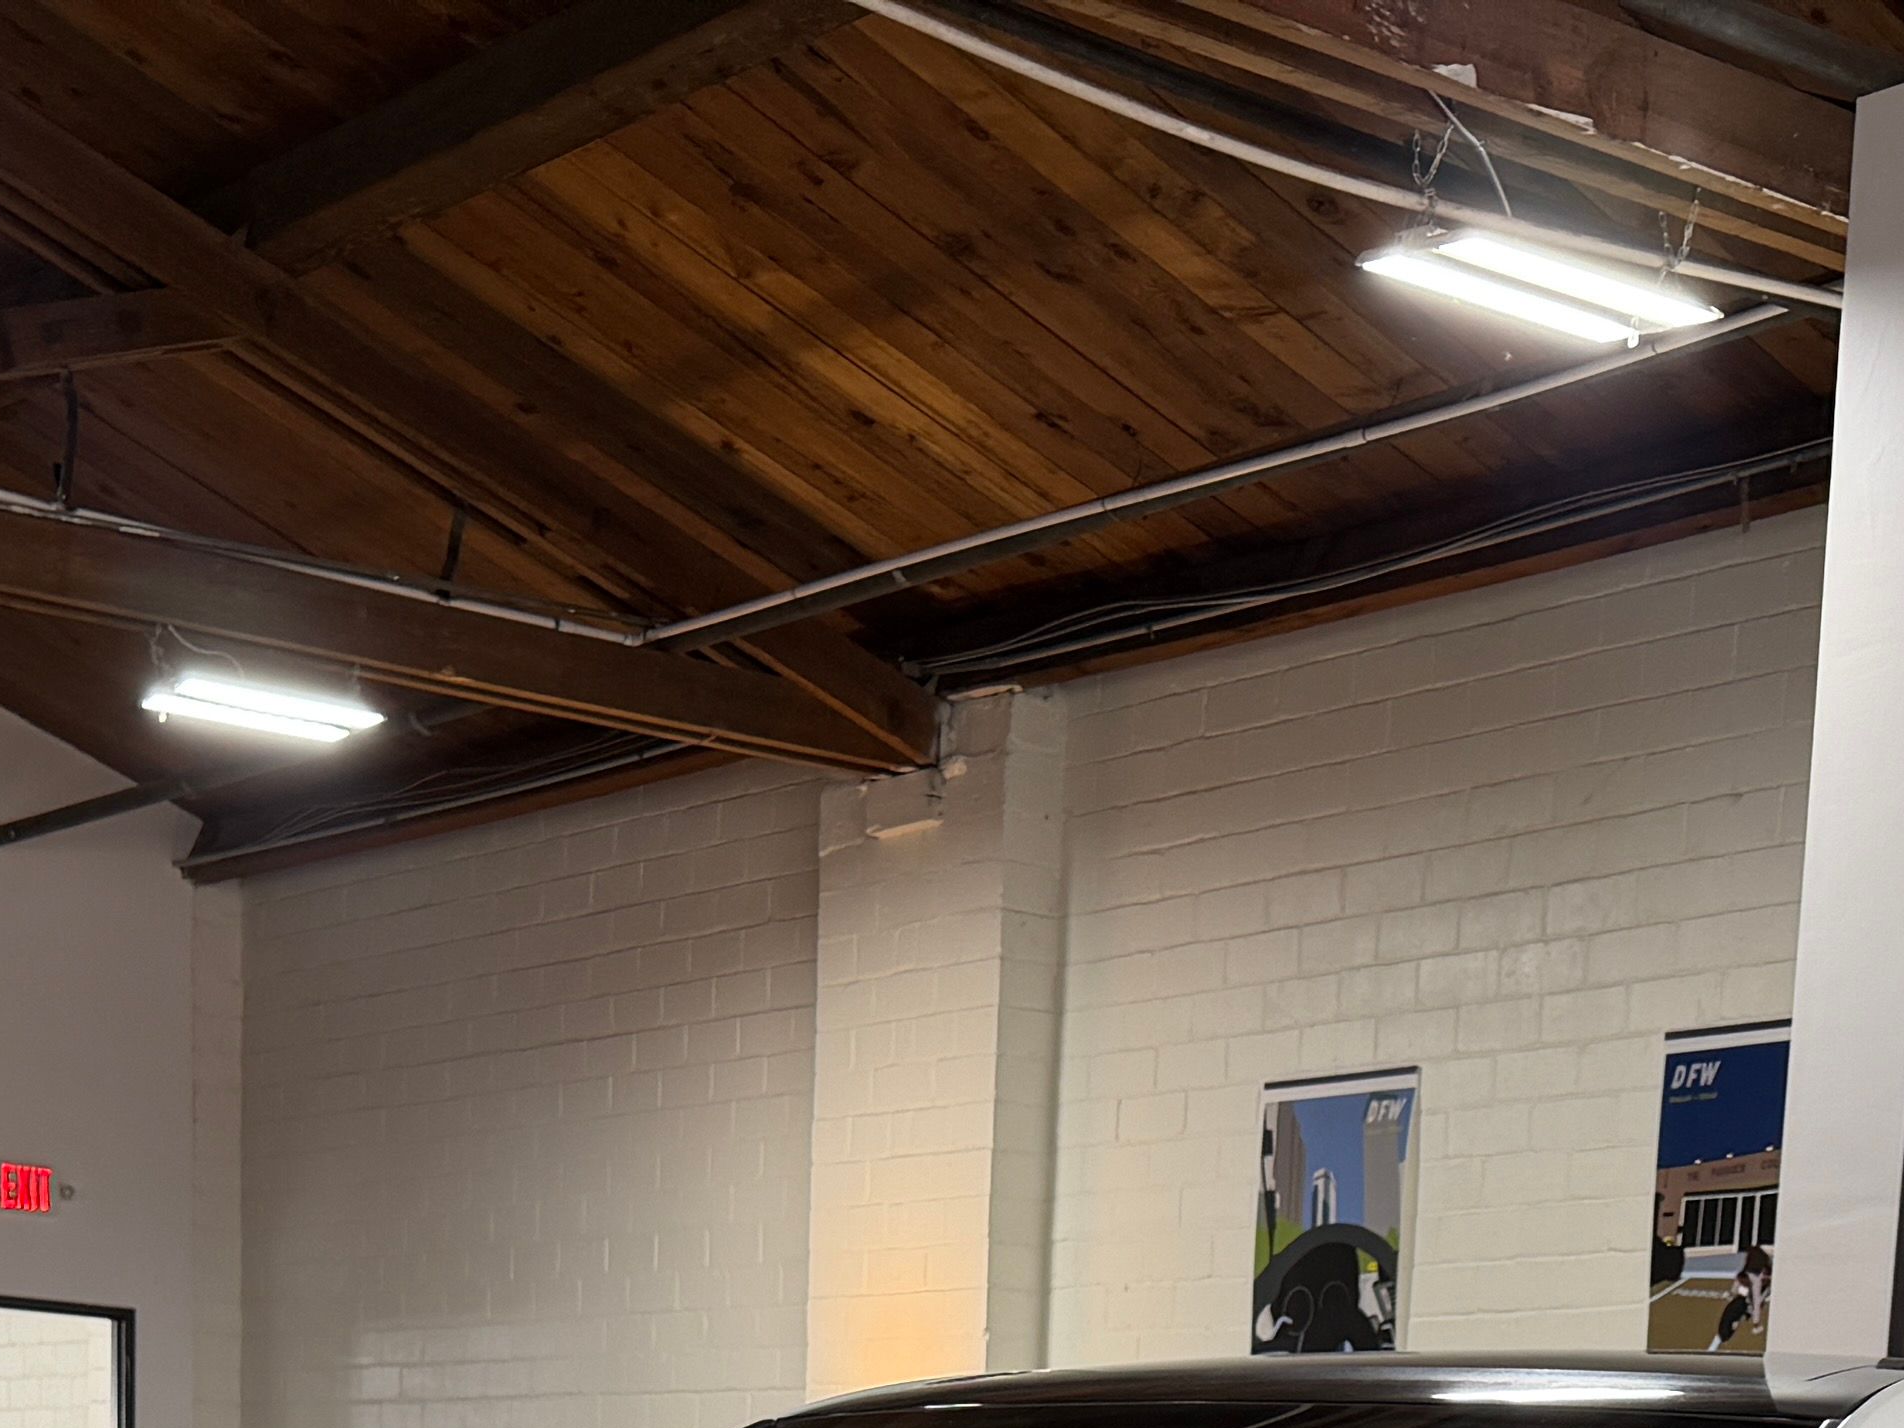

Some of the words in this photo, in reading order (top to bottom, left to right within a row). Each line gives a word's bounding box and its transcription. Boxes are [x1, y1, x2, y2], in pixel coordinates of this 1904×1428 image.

[1671, 1060, 1721, 1090] DFW
[1366, 1098, 1406, 1123] DFW
[0, 1162, 53, 1212] EXIT
